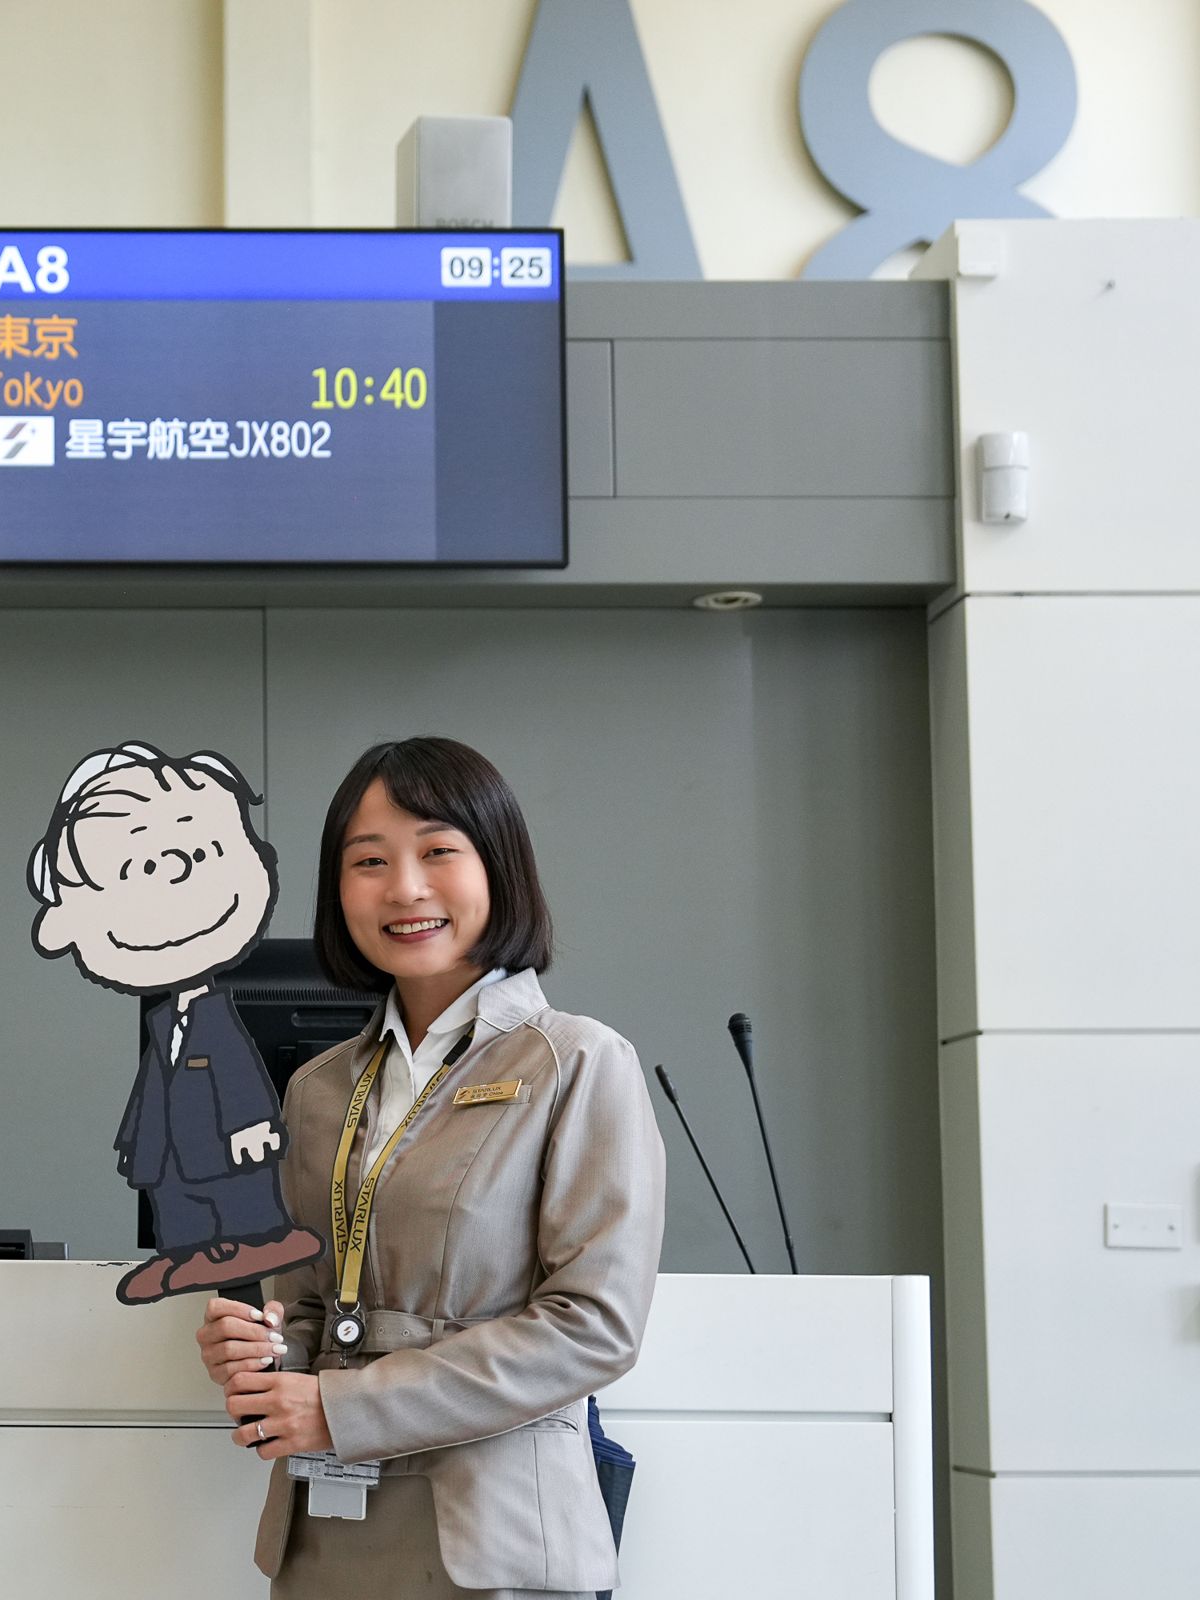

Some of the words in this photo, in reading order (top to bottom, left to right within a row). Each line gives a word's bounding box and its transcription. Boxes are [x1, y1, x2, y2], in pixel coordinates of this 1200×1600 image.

[510, 0, 1079, 281] A8
[448, 255, 545, 281] 09:25
[311, 367, 428, 409] 10:40
[65, 418, 332, 460] 星宇航空JX802
[347, 1071, 376, 1129] STARLUX
[333, 1178, 348, 1254] STARLUX
[350, 1177, 375, 1252] STARLUX
